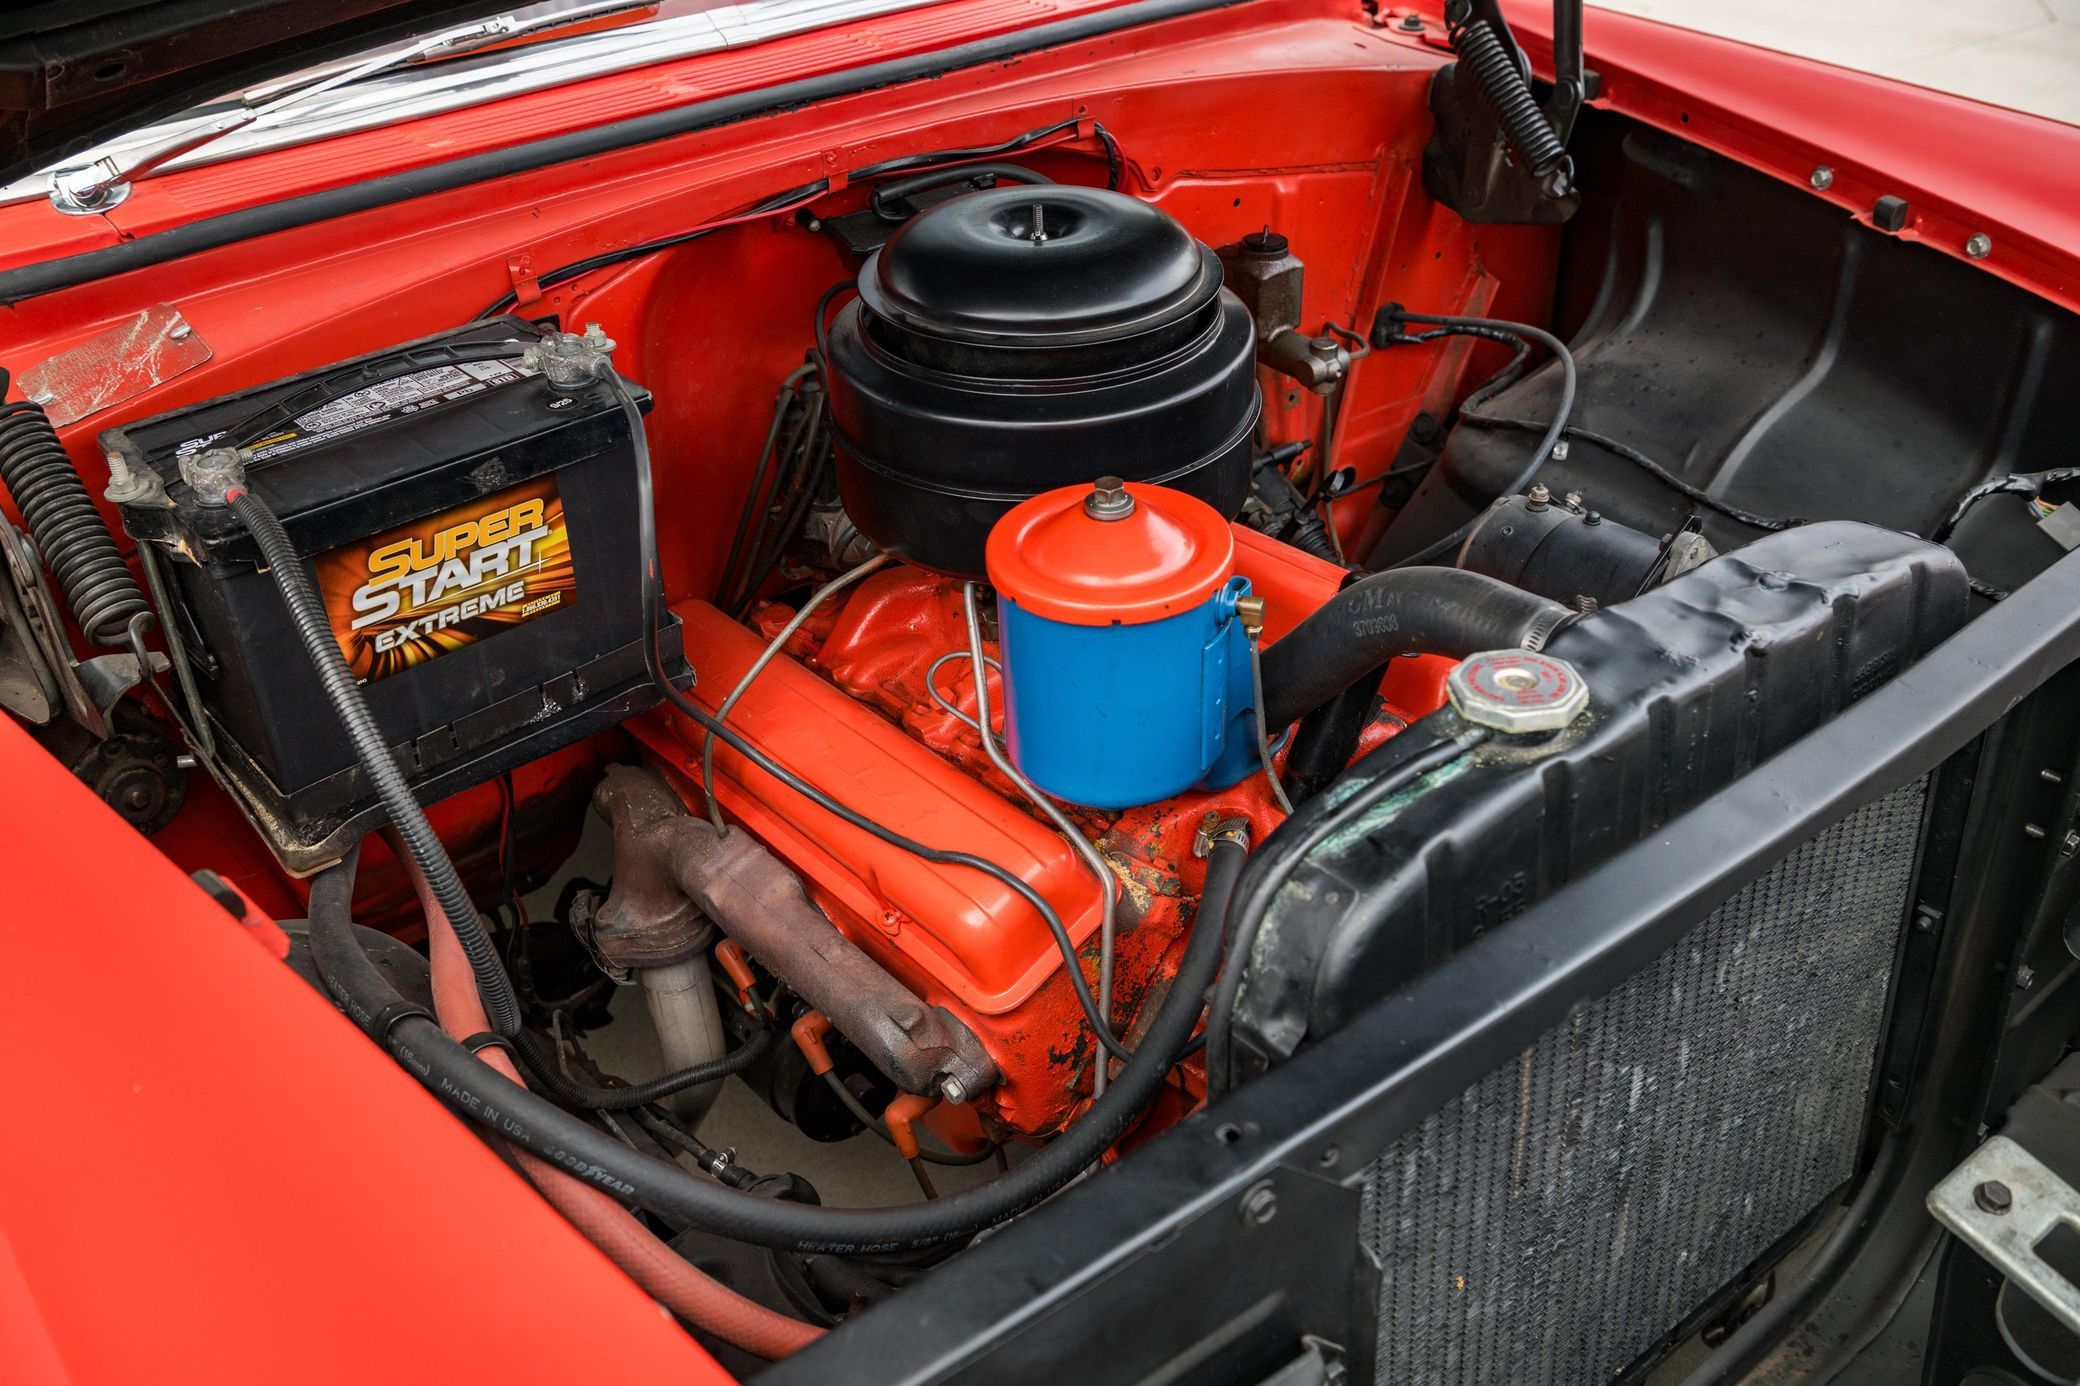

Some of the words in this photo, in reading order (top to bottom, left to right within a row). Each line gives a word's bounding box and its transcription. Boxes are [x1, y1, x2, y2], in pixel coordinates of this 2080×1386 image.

[352, 525, 549, 631] START
[368, 498, 544, 588] SUPER
[375, 580, 526, 653] EXTREME
[441, 1078, 480, 1110] MADE
[484, 1105, 500, 1122] IN
[503, 1118, 531, 1143] USA
[543, 1144, 635, 1195] GOODYEAR
[797, 1240, 856, 1254] HEATER
[860, 1242, 899, 1253] HOSE
